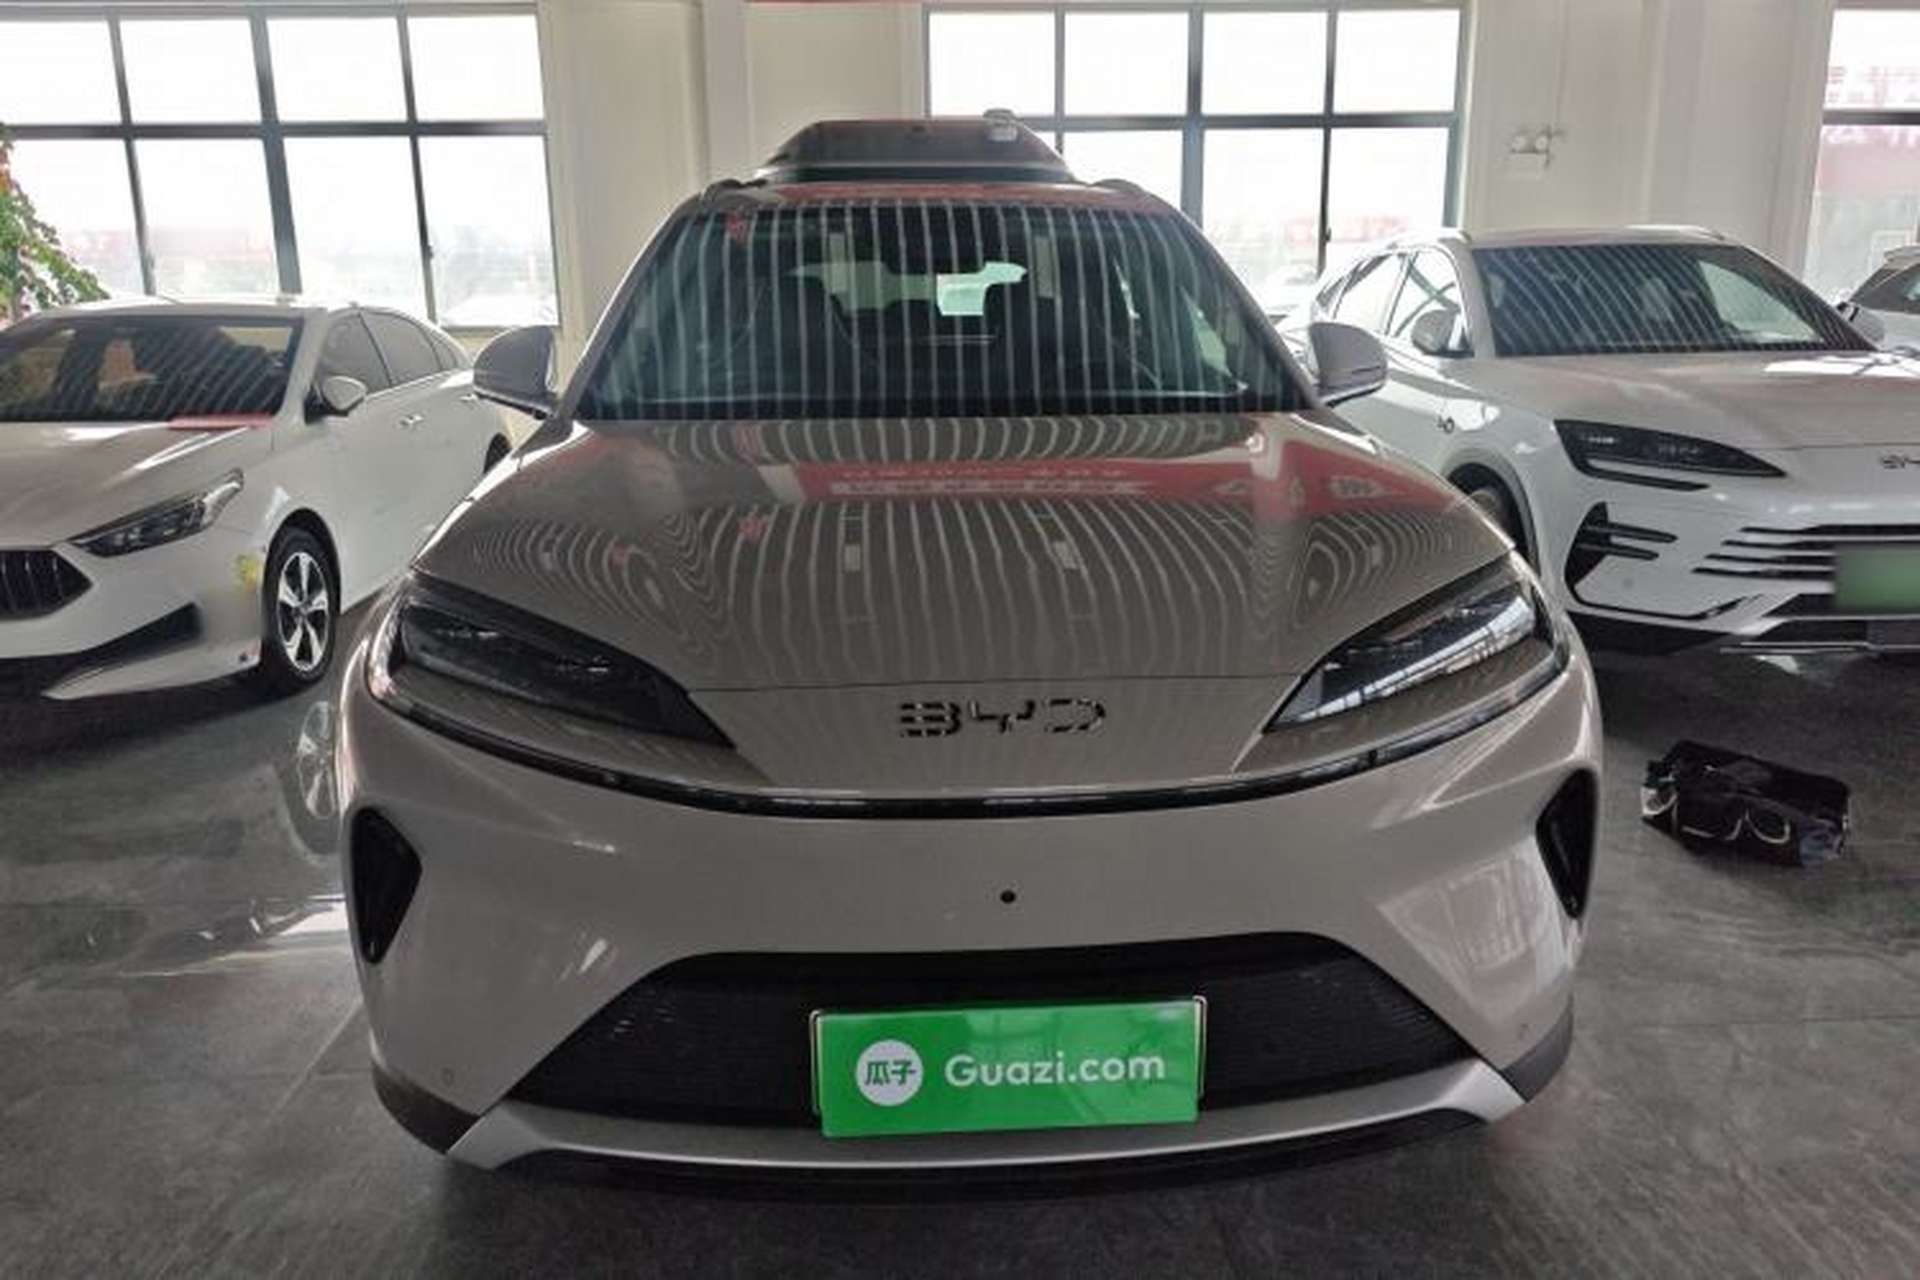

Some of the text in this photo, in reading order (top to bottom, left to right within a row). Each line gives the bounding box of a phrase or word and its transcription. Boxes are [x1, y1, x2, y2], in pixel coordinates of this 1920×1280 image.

[898, 696, 1107, 738] BYD
[863, 1059, 918, 1086] 瓜子
[944, 1050, 1166, 1088] Guazi.com
